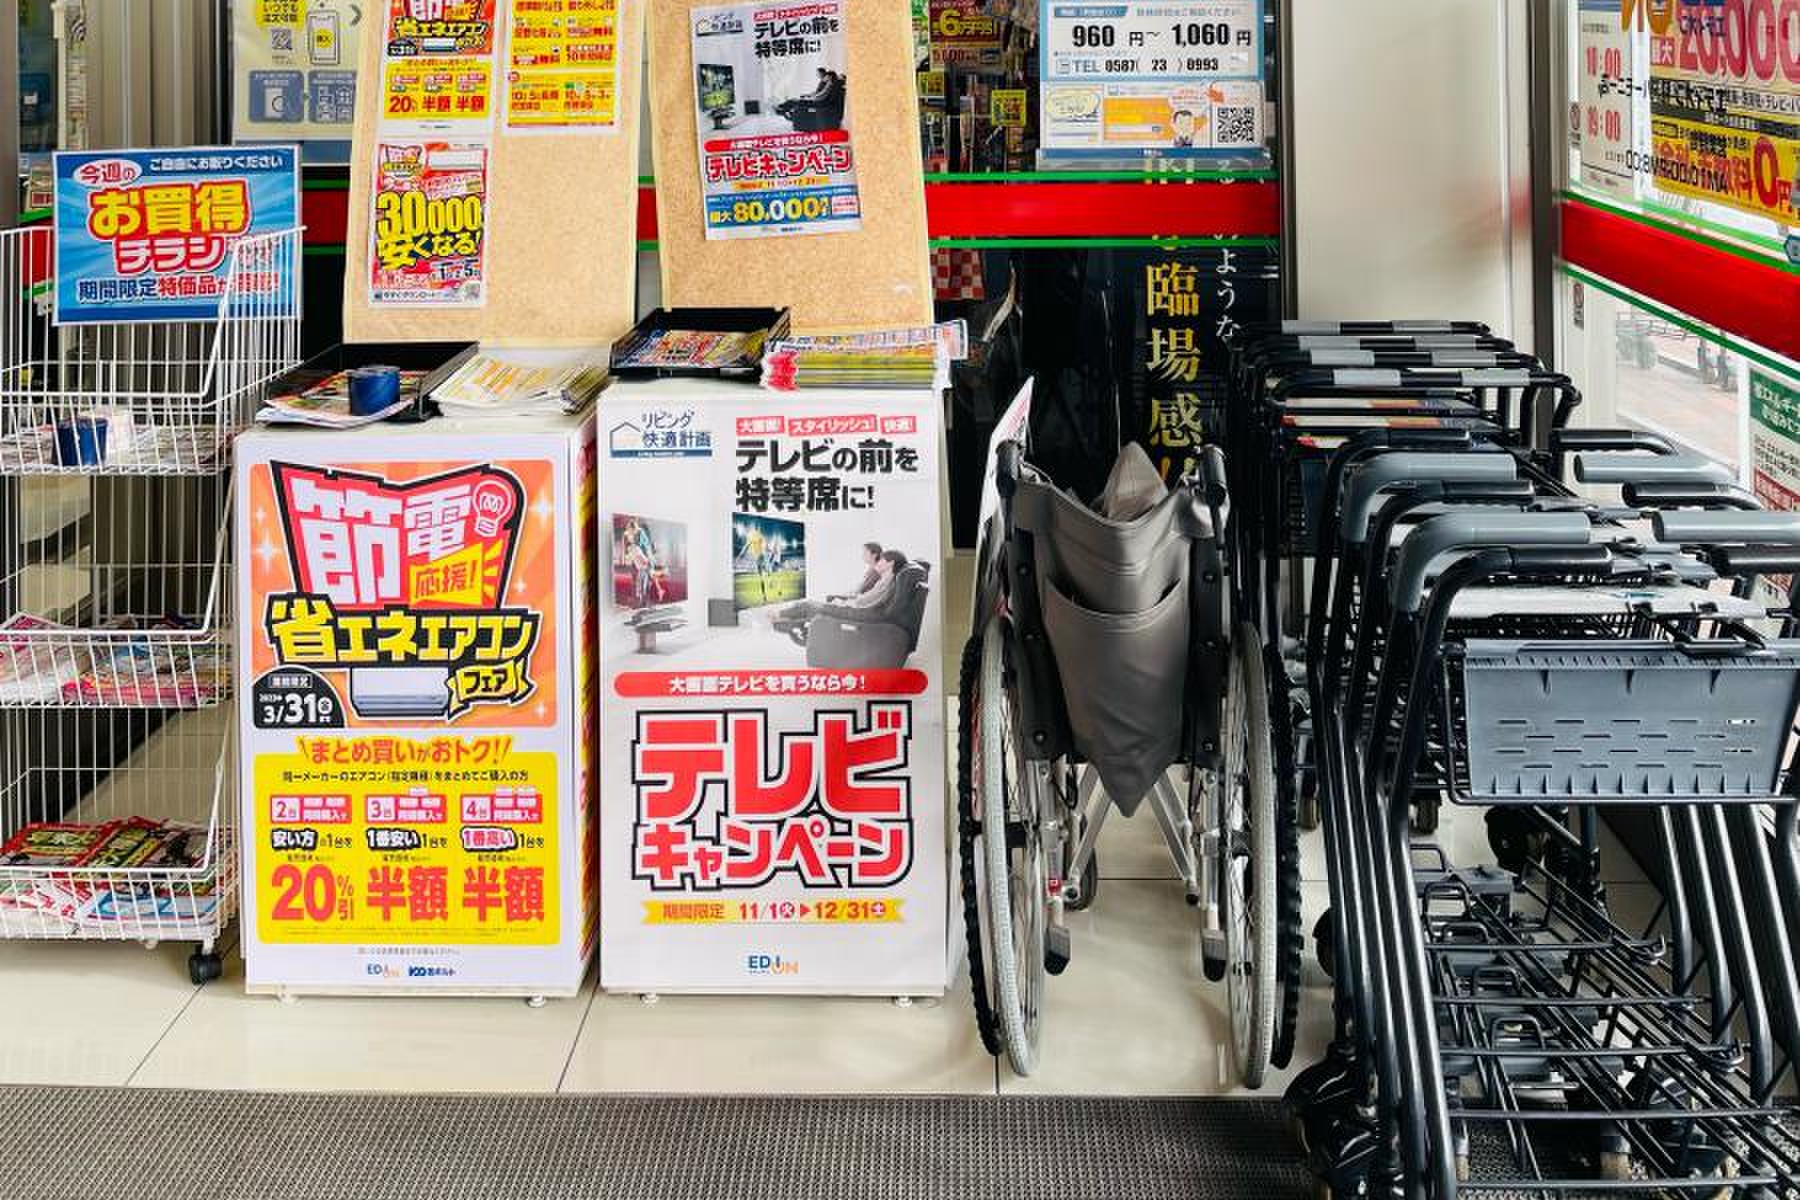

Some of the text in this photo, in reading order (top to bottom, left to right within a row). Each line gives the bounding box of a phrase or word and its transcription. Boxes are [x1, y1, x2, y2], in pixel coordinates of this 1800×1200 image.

[755, 16, 839, 40] テレビの前を
[1072, 25, 1115, 47] 960
[1171, 23, 1230, 48] 1,060
[1072, 60, 1100, 73] TEL
[80, 162, 135, 183] 今週の
[706, 148, 850, 181] テレビキャンペーン
[91, 182, 246, 238] お買得
[117, 237, 223, 272] チラシ
[642, 409, 695, 429] リビング
[642, 430, 711, 449] 快適計画
[736, 438, 918, 474] テレビの前を
[736, 476, 875, 513] 特等席に!
[290, 477, 472, 604] 節電
[415, 559, 477, 597] 応援!
[271, 599, 531, 663] 省エネエアコン
[464, 665, 508, 693] フェア
[671, 675, 865, 694] 大画面テレビを買うなら今!
[637, 707, 906, 820] テレビ
[637, 818, 910, 884] キャンペーン
[366, 866, 449, 922] 半額
[462, 866, 545, 922] 半額
[663, 902, 726, 919] 期間限定
